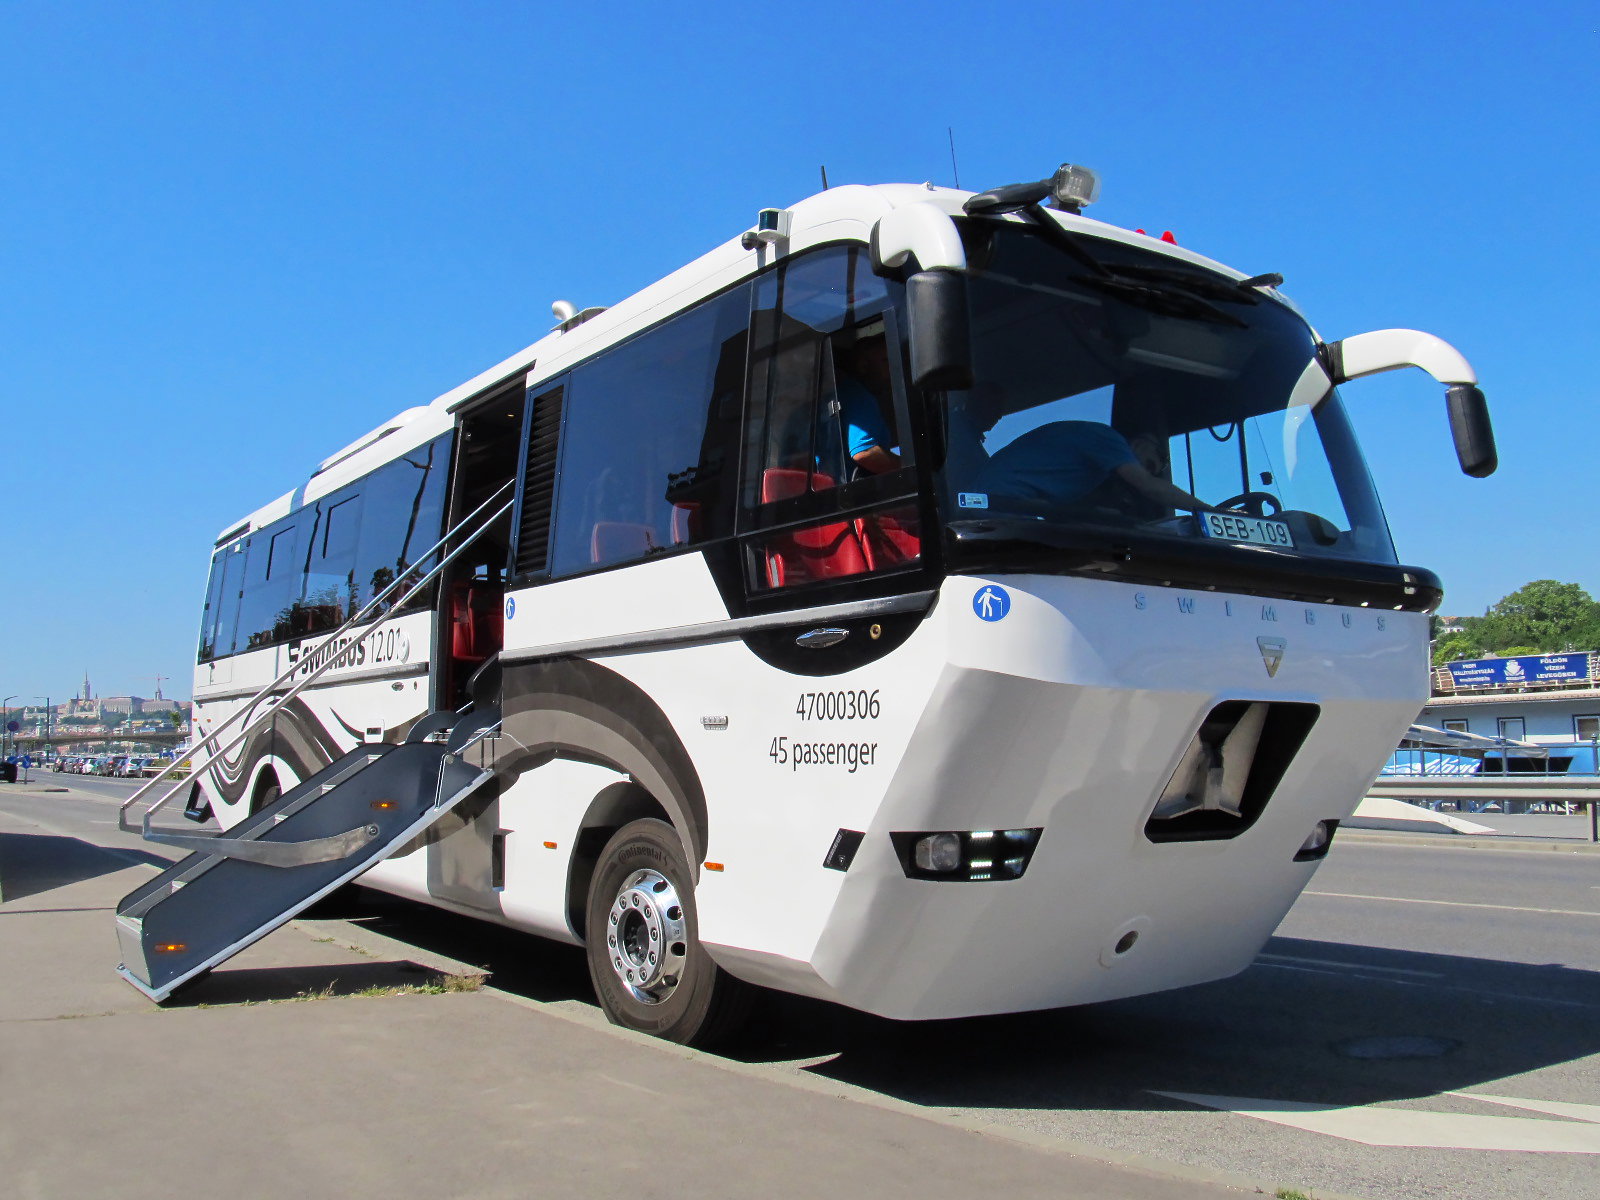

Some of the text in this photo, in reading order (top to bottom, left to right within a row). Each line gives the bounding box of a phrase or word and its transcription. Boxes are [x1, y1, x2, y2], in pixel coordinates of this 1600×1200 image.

[1210, 515, 1288, 544] SEB-109
[1134, 591, 1387, 631] SWIMBUS
[796, 689, 880, 721] 47000306
[769, 736, 878, 773] 45 passenger
[618, 844, 662, 865] Continental
